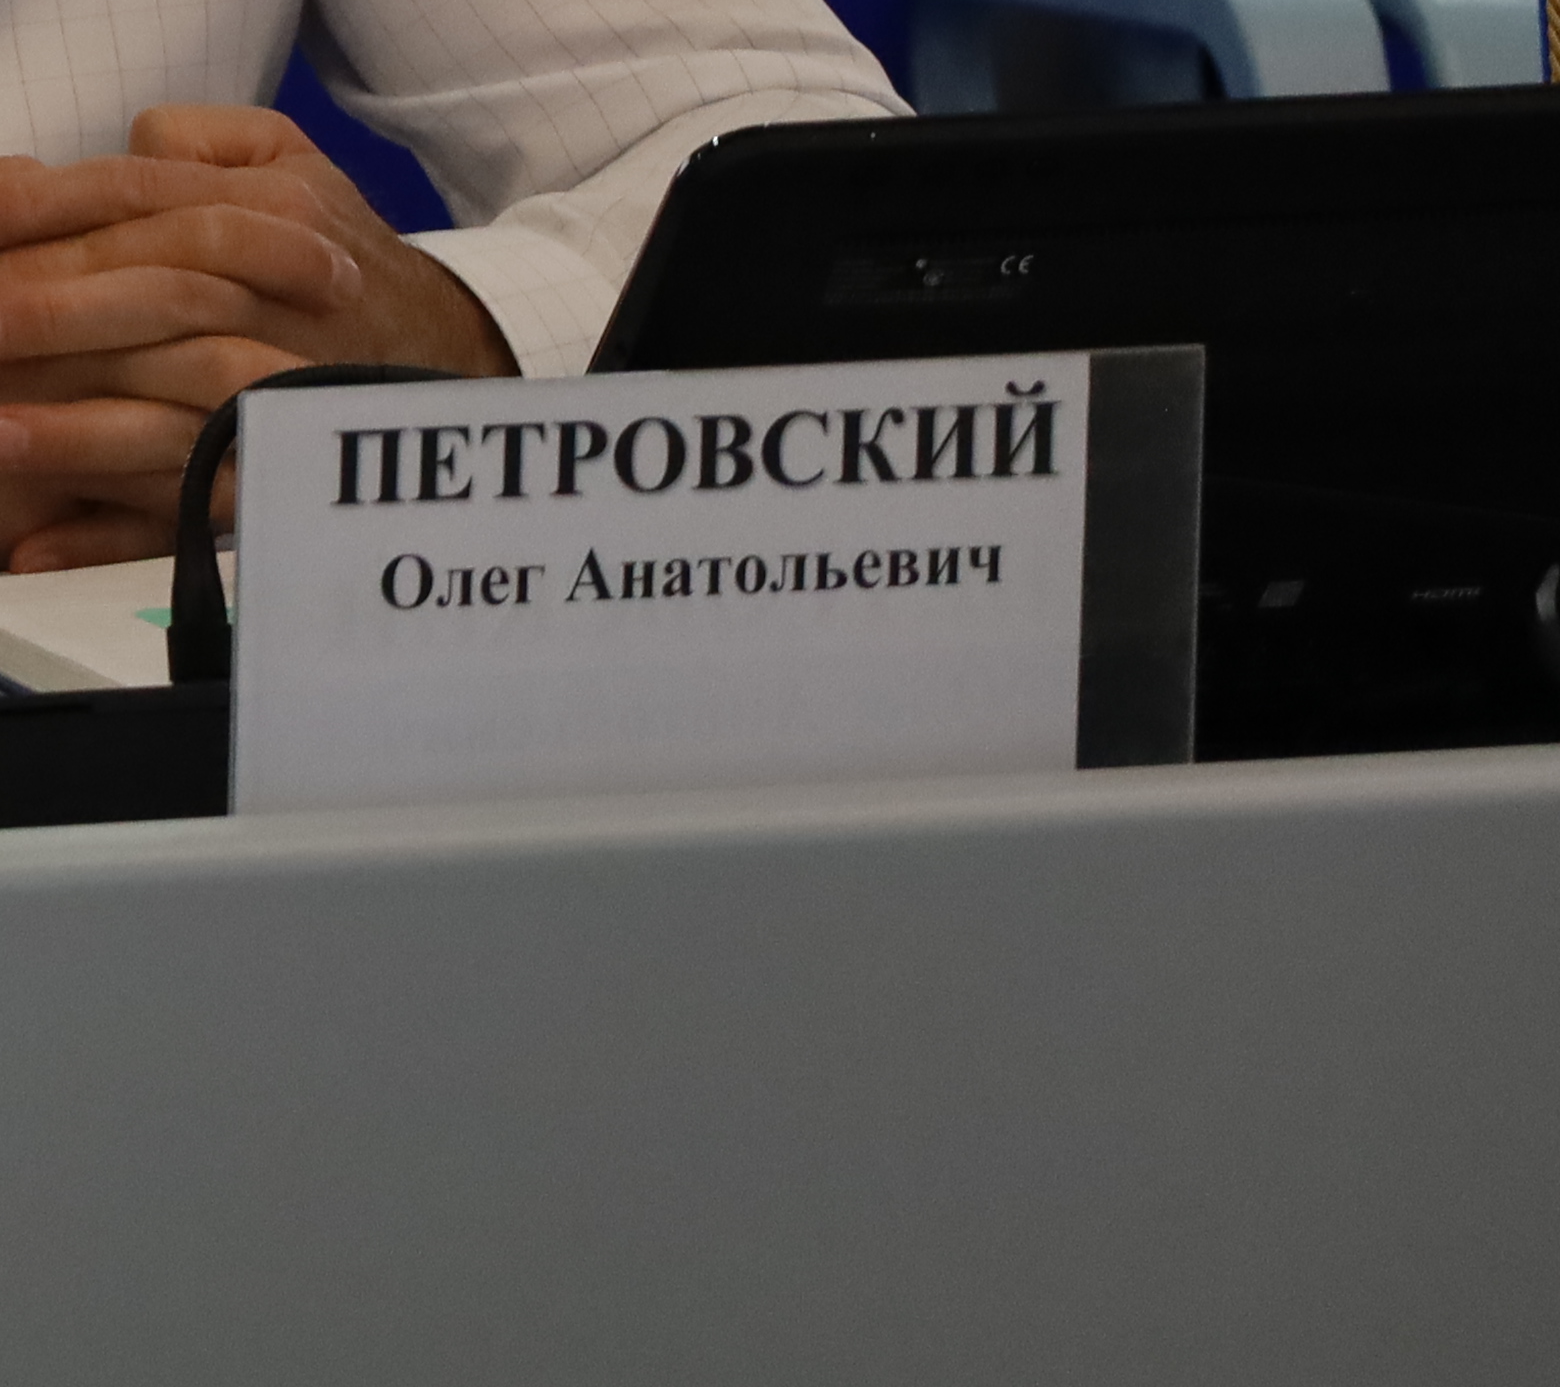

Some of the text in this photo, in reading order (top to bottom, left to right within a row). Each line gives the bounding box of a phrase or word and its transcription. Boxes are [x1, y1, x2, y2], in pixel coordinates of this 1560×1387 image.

[332, 380, 1060, 507] ПЕТРОВСКИЙ
[380, 544, 1003, 611] Олег Анатольевич
